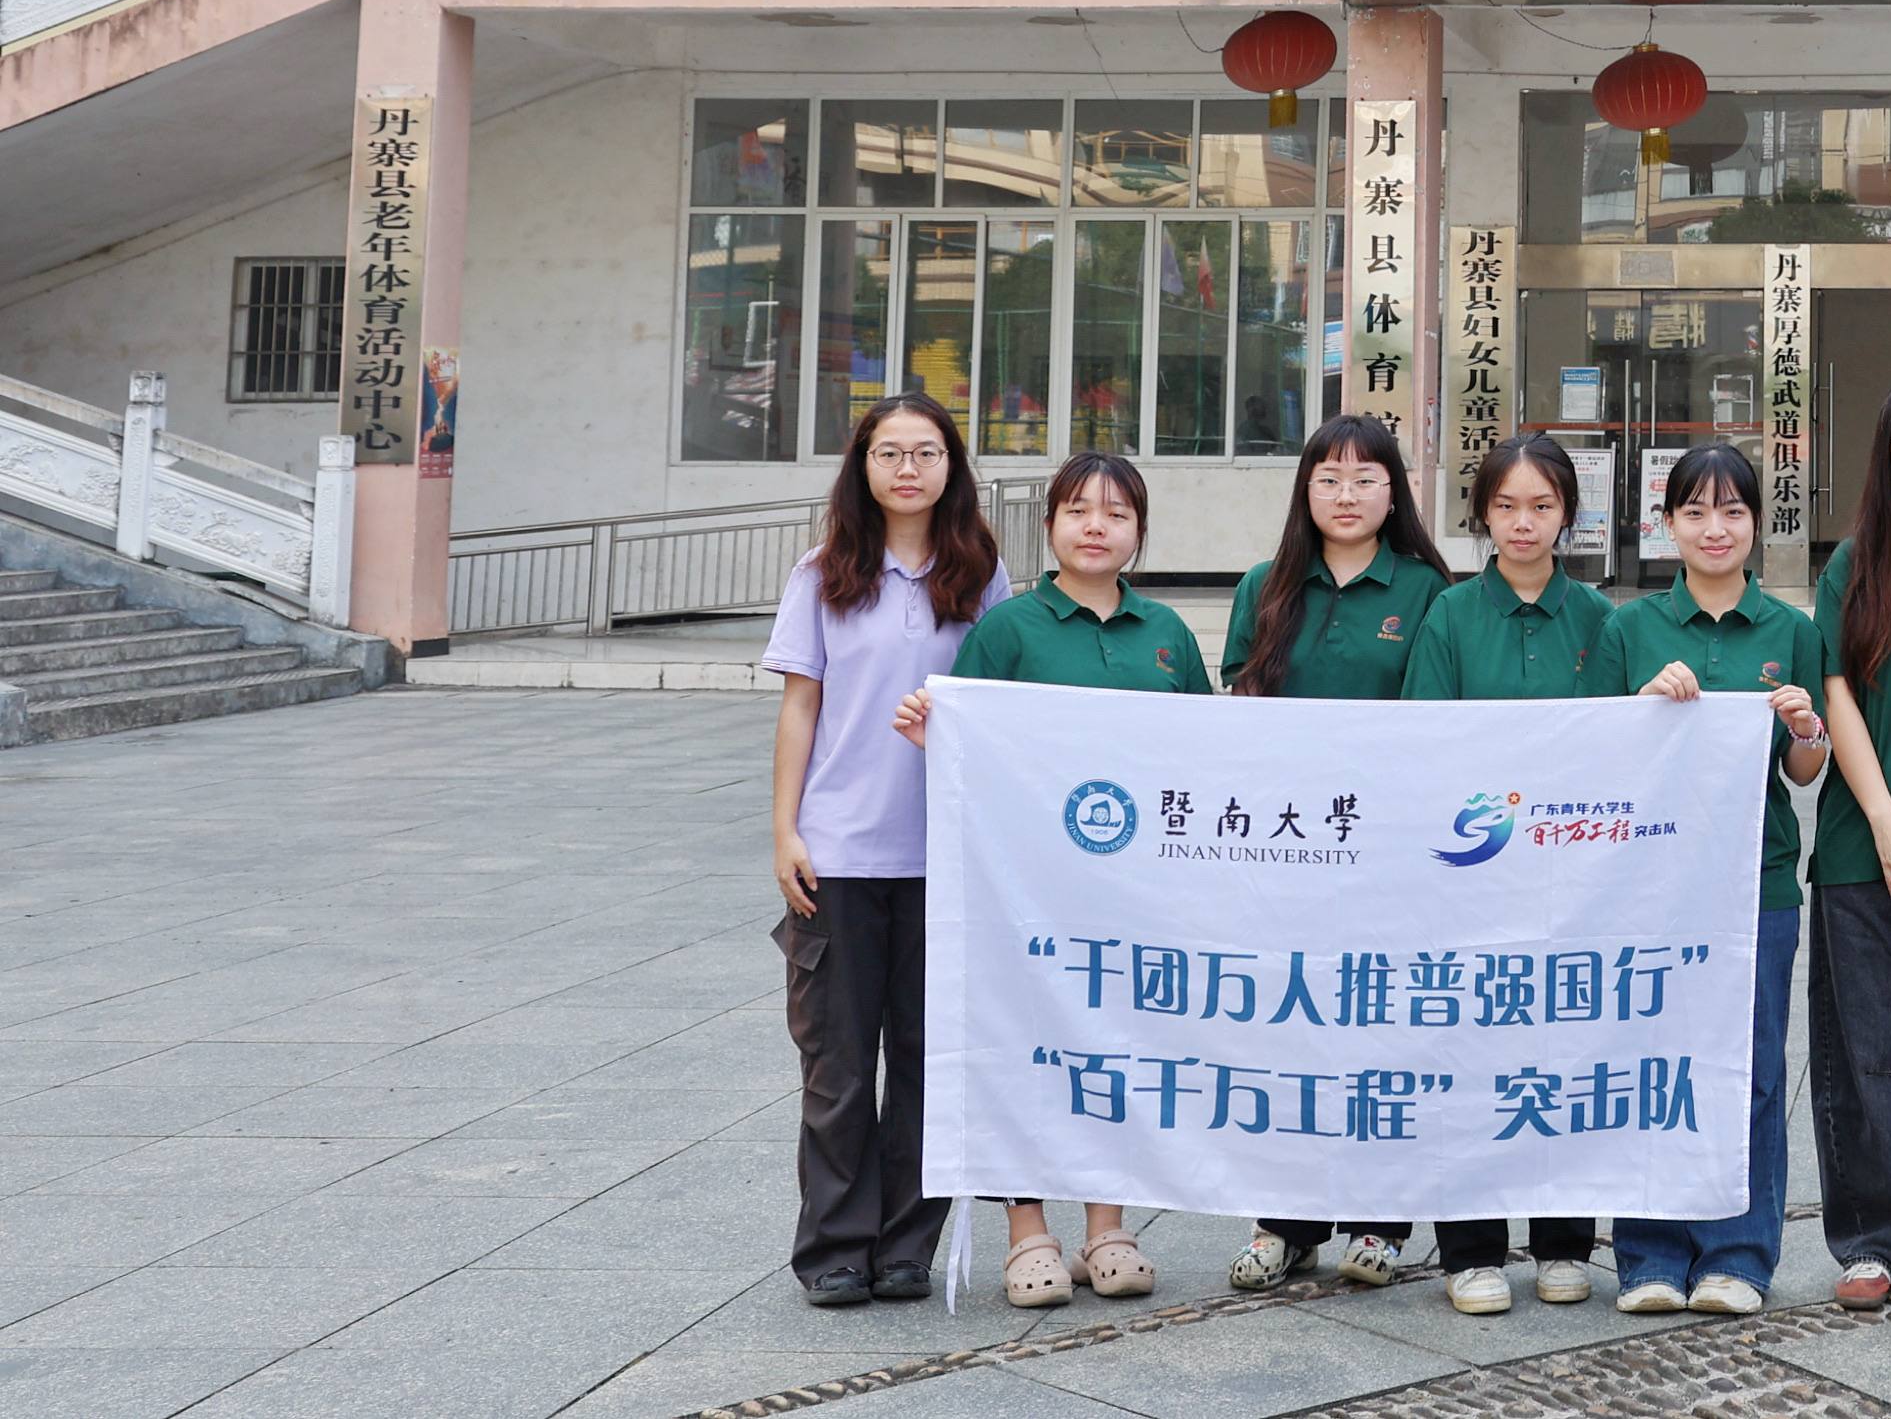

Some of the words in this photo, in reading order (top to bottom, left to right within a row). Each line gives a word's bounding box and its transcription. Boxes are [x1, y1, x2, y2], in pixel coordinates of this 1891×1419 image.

[353, 107, 420, 451] 丹寨县老年体育活动中心
[1771, 253, 1802, 535] 丹寨厚德武道俱乐部
[1525, 820, 1631, 848] 百千万工程
[1634, 822, 1678, 838] 突击队
[1530, 801, 1635, 816] 广东青年大学生
[1158, 843, 1222, 861] JINAN
[1229, 847, 1361, 865] UNIVERSITY
[1491, 1056, 1700, 1141] 突击队
